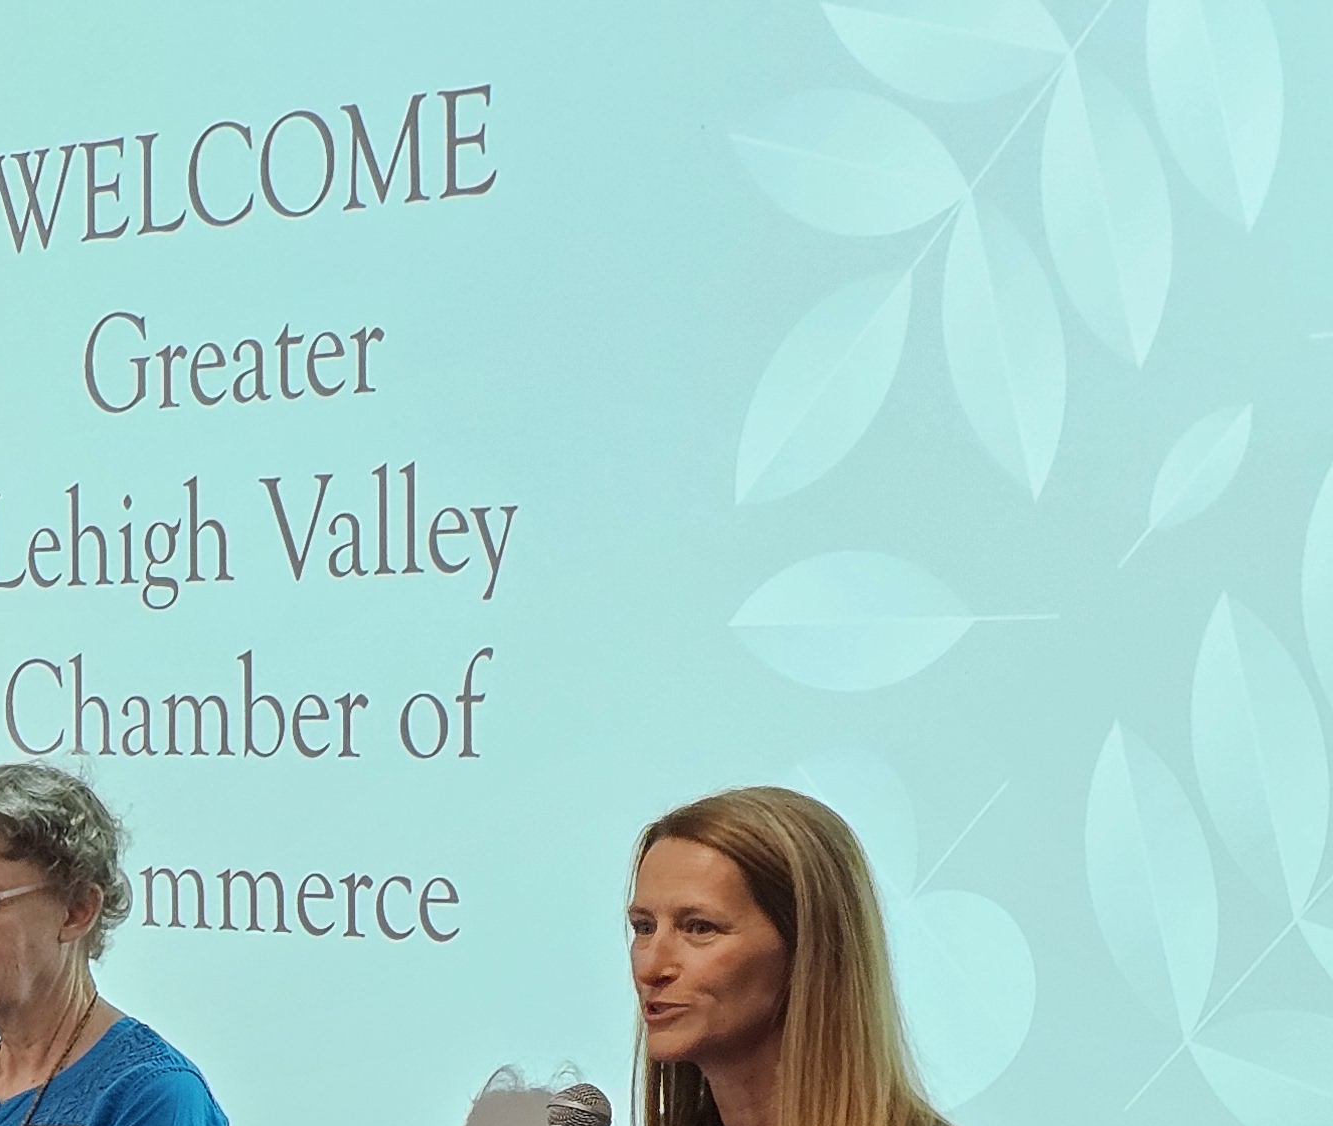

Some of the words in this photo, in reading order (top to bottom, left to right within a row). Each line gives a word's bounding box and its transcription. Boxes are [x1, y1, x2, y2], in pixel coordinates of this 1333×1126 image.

[84, 311, 385, 414] Greater
[258, 460, 519, 601] Valley
[5, 649, 369, 759] Chamber
[399, 646, 494, 759] of
[139, 865, 461, 943] mmerce
